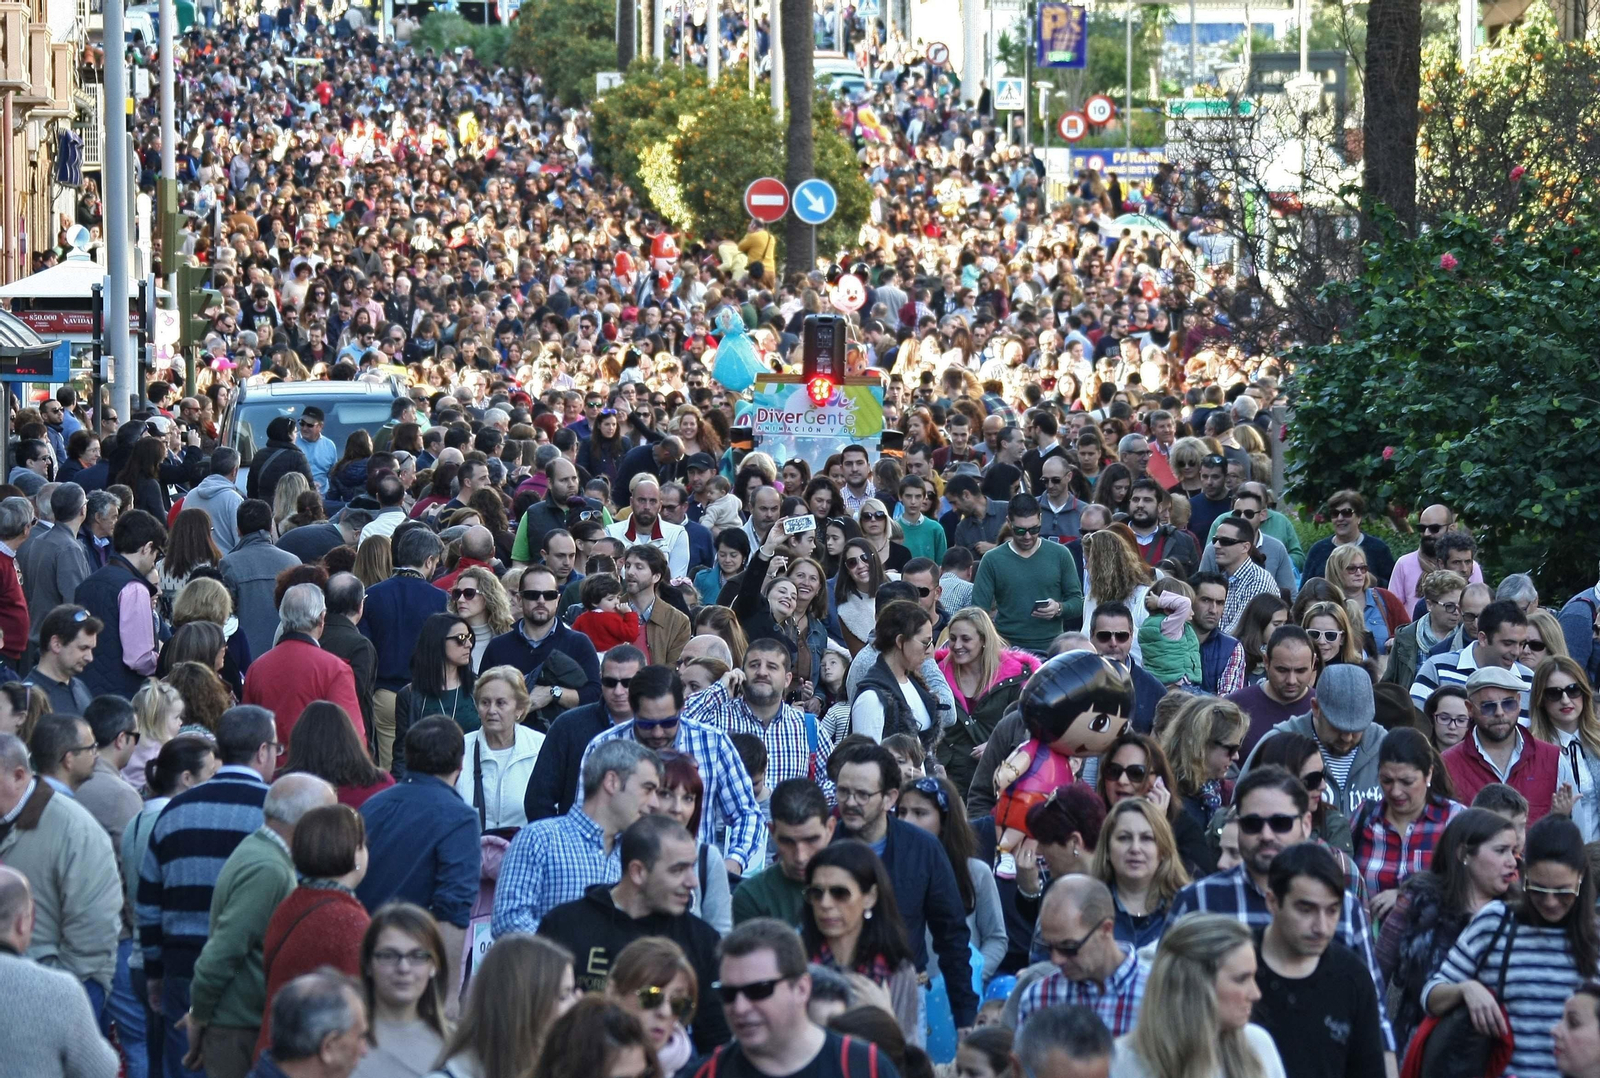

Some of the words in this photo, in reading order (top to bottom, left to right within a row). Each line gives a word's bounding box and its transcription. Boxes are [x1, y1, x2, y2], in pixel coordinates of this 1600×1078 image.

[1093, 106, 1106, 115] 10
[757, 408, 855, 426] DiverGente
[757, 425, 821, 433] ANIMACIÓN
